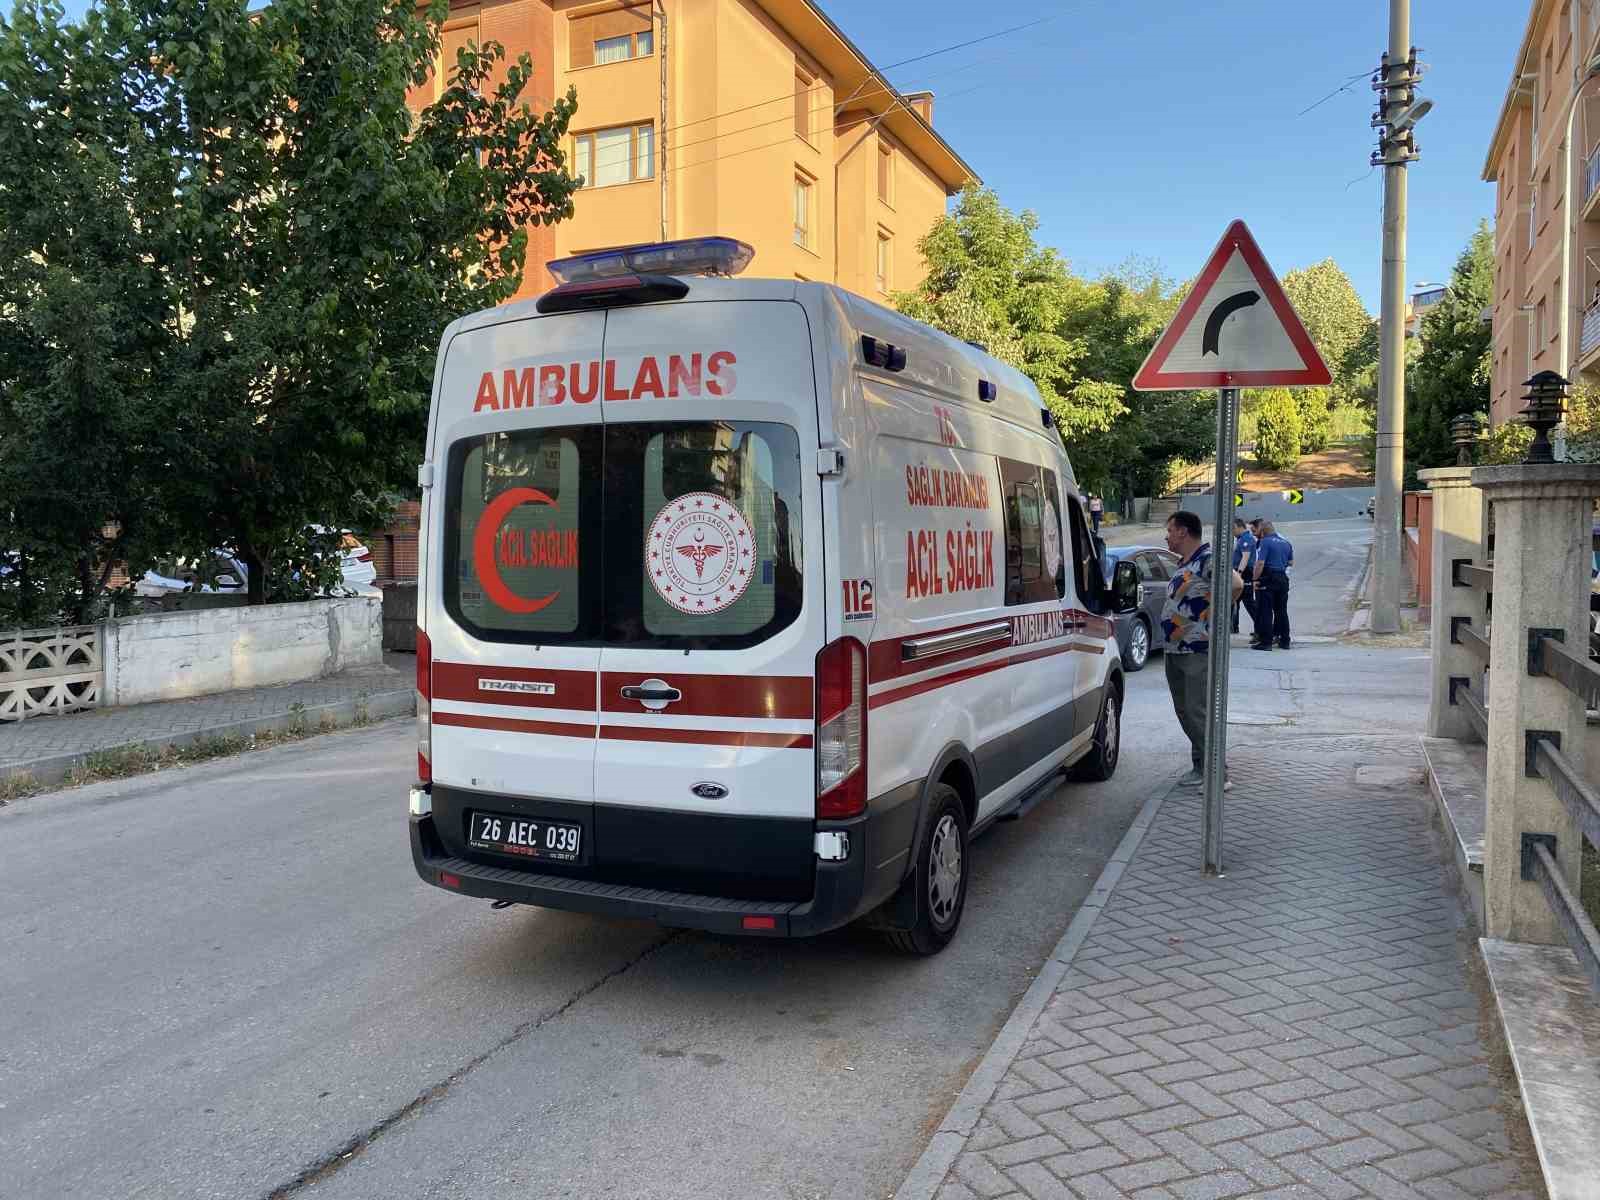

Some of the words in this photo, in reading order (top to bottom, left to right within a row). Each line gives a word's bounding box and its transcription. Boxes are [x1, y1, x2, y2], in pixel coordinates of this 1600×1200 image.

[473, 351, 736, 412] AMBULANS
[905, 460, 943, 506] SAĞLIK
[946, 519, 994, 593] SAĞLIK
[843, 580, 873, 612] 112
[1012, 611, 1064, 645] AMBULANS
[479, 679, 555, 694] TRANSIT
[481, 818, 501, 840] 26
[507, 821, 538, 845] AEC
[546, 826, 578, 851] 039
